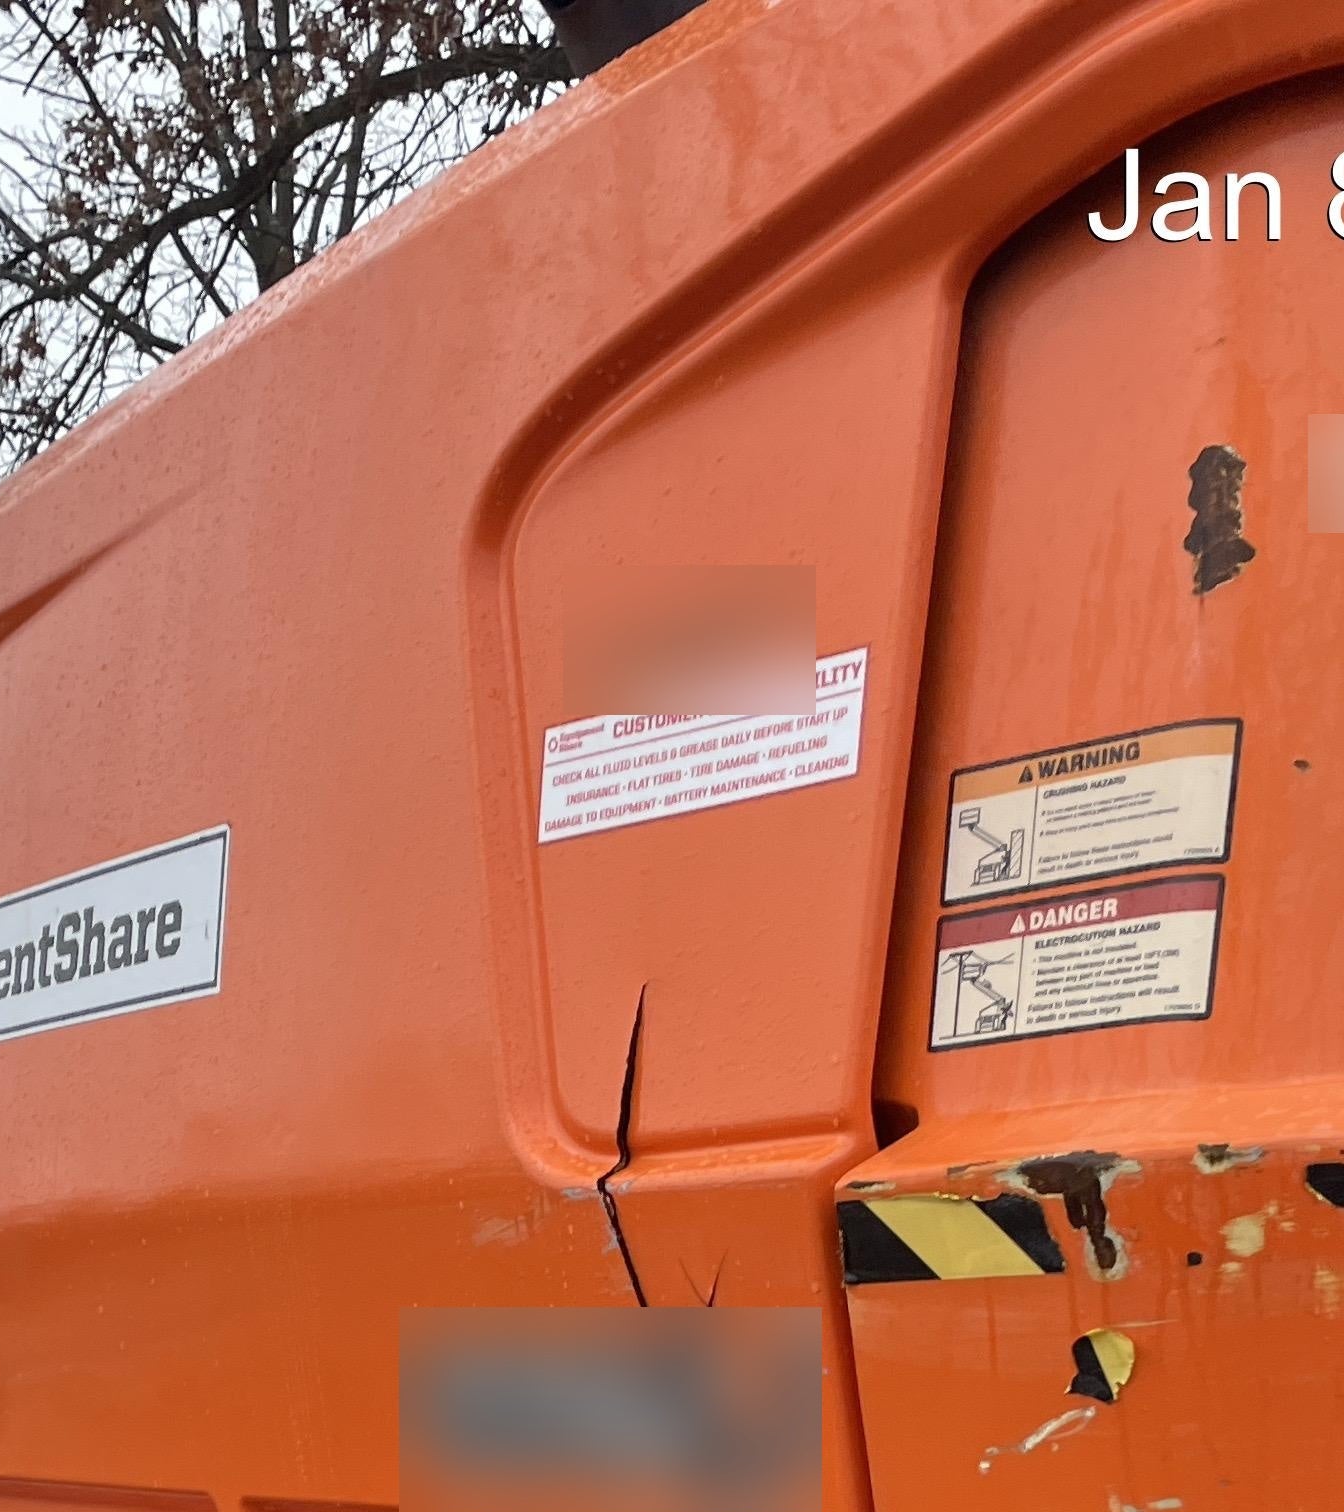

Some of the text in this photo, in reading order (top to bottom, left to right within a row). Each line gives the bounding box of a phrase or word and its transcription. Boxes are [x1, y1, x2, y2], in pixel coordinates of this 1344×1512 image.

[552, 769, 582, 787] CHECK
[584, 765, 601, 779] ALL
[603, 759, 632, 774] FLUID
[633, 751, 668, 768] LEVELS
[679, 737, 719, 758] GREASE
[721, 730, 751, 749] DAILY
[753, 719, 794, 741] BEFORE
[796, 711, 831, 730] START
[832, 706, 848, 721] UP
[565, 734, 829, 807] INSURANCE FLAT TIRES TIRE DAMAGE REFUELING
[1038, 741, 1141, 779] WARNING
[544, 753, 850, 832] DAMAGE TO EQUIPMENT BATTERY MAINTENANCE CLEANING
[1029, 897, 1119, 931] DANGER
